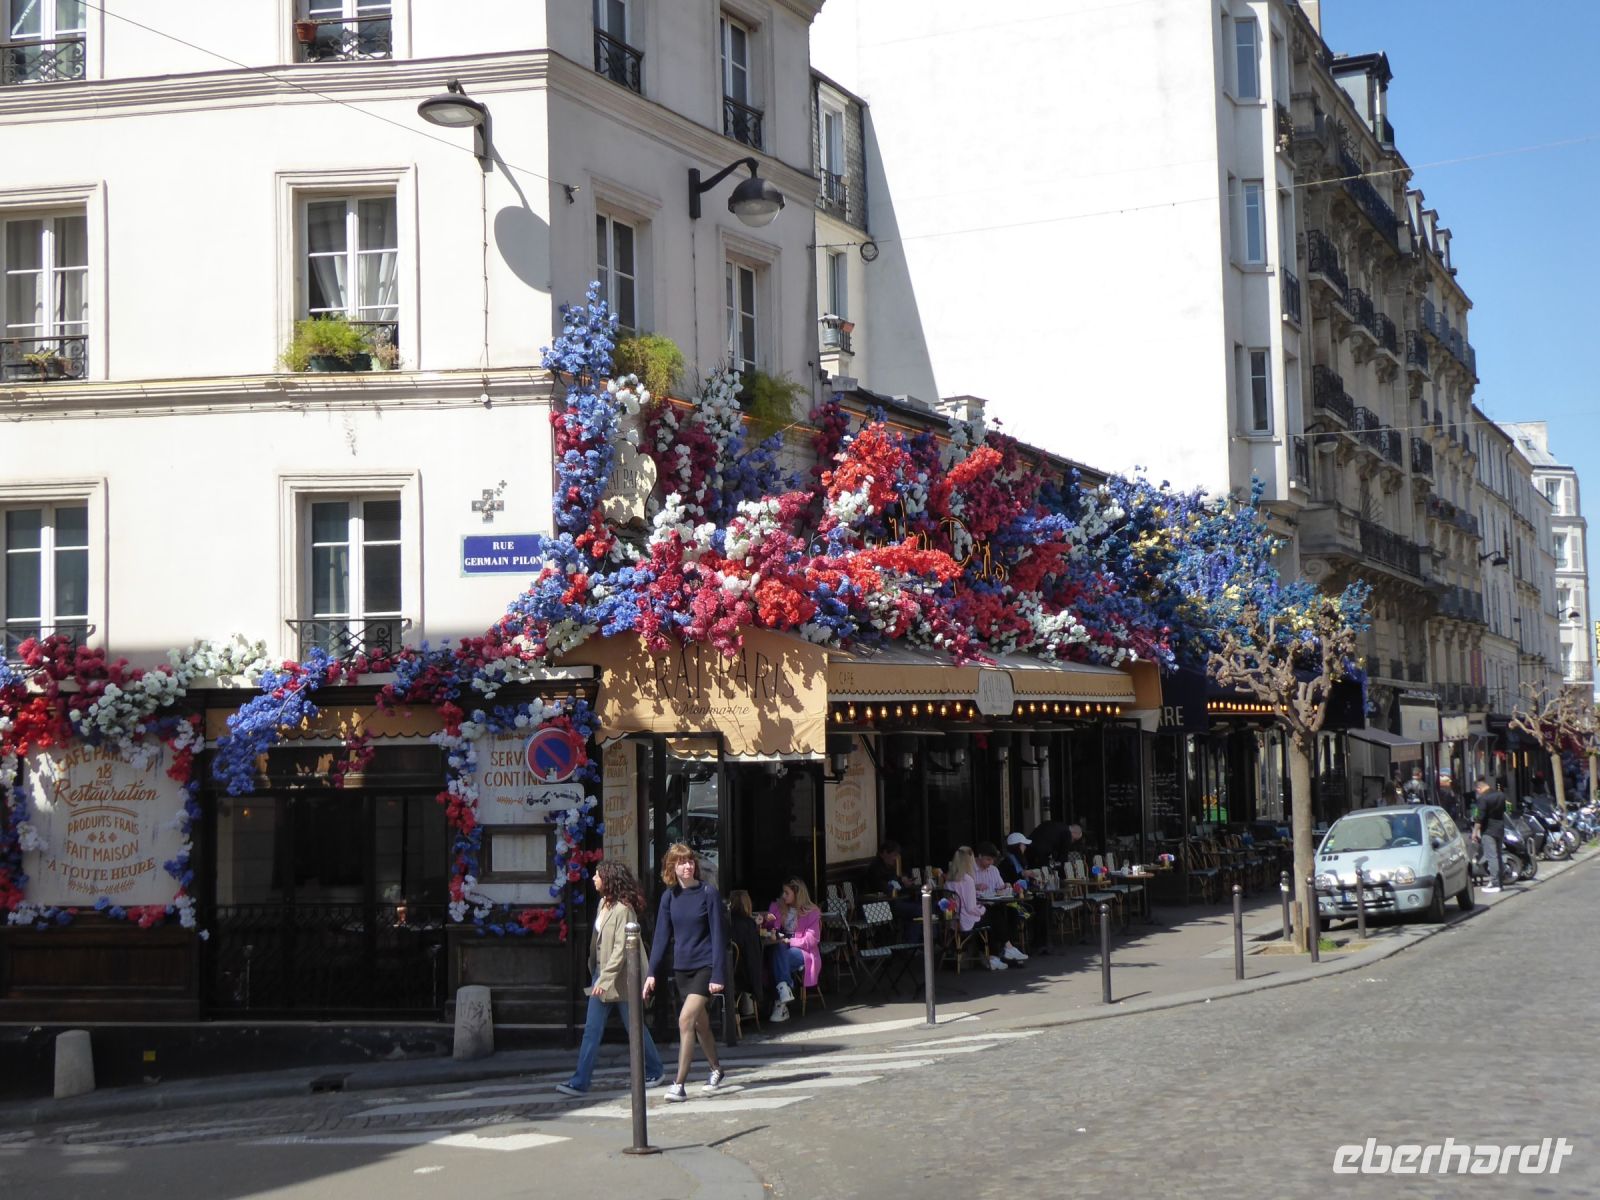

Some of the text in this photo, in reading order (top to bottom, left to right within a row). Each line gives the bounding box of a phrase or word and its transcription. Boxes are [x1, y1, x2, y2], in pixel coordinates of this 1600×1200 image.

[492, 541, 515, 551] RUE
[464, 555, 543, 566] GERMAIN PILON
[635, 641, 795, 699] VRAI PARIS
[681, 703, 751, 715] Montmartre
[1159, 705, 1185, 727] RE
[490, 751, 526, 767] SERVI
[96, 764, 113, 779] 18
[53, 779, 160, 807] Restauration
[67, 815, 139, 836] PRODUITS FRAIS
[98, 831, 106, 844] &
[65, 840, 139, 862] FAIT MAISON
[61, 863, 109, 881] TOUTE
[110, 857, 156, 880] HEURE
